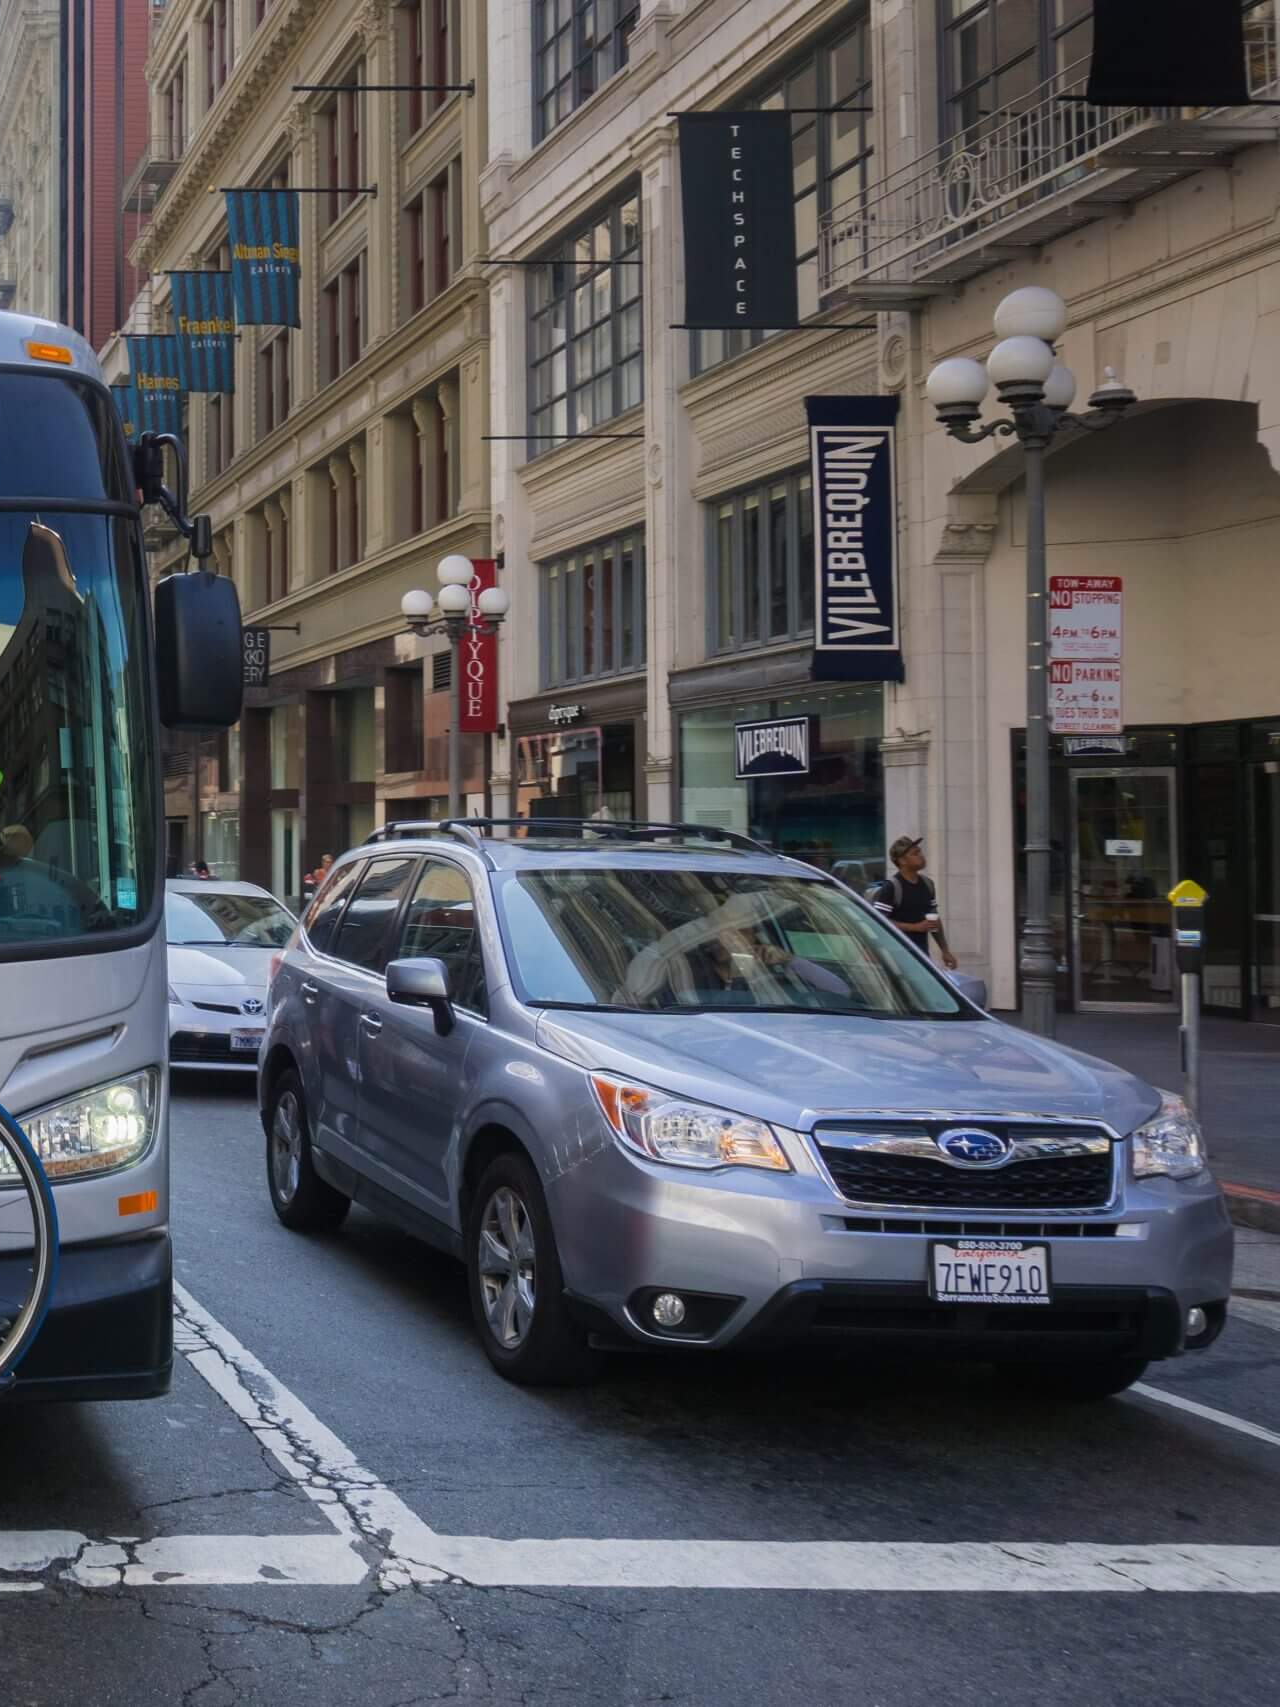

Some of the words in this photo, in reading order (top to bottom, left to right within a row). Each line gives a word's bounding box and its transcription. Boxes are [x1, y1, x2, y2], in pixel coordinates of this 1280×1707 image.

[730, 125, 747, 314] TECHSPACE
[250, 263, 291, 275] gallery
[136, 372, 180, 390] Haines
[823, 436, 891, 639] VILEBREQUIN
[1056, 578, 1115, 589] TOW-AWAY
[1050, 591, 1070, 606] NO
[1074, 593, 1120, 605] STOPPING
[1052, 663, 1070, 682] NO
[1075, 668, 1120, 682] PARKING
[737, 723, 807, 773] VILEBREQUIN
[937, 1293, 1050, 1304] SerramonteSubaru.com
